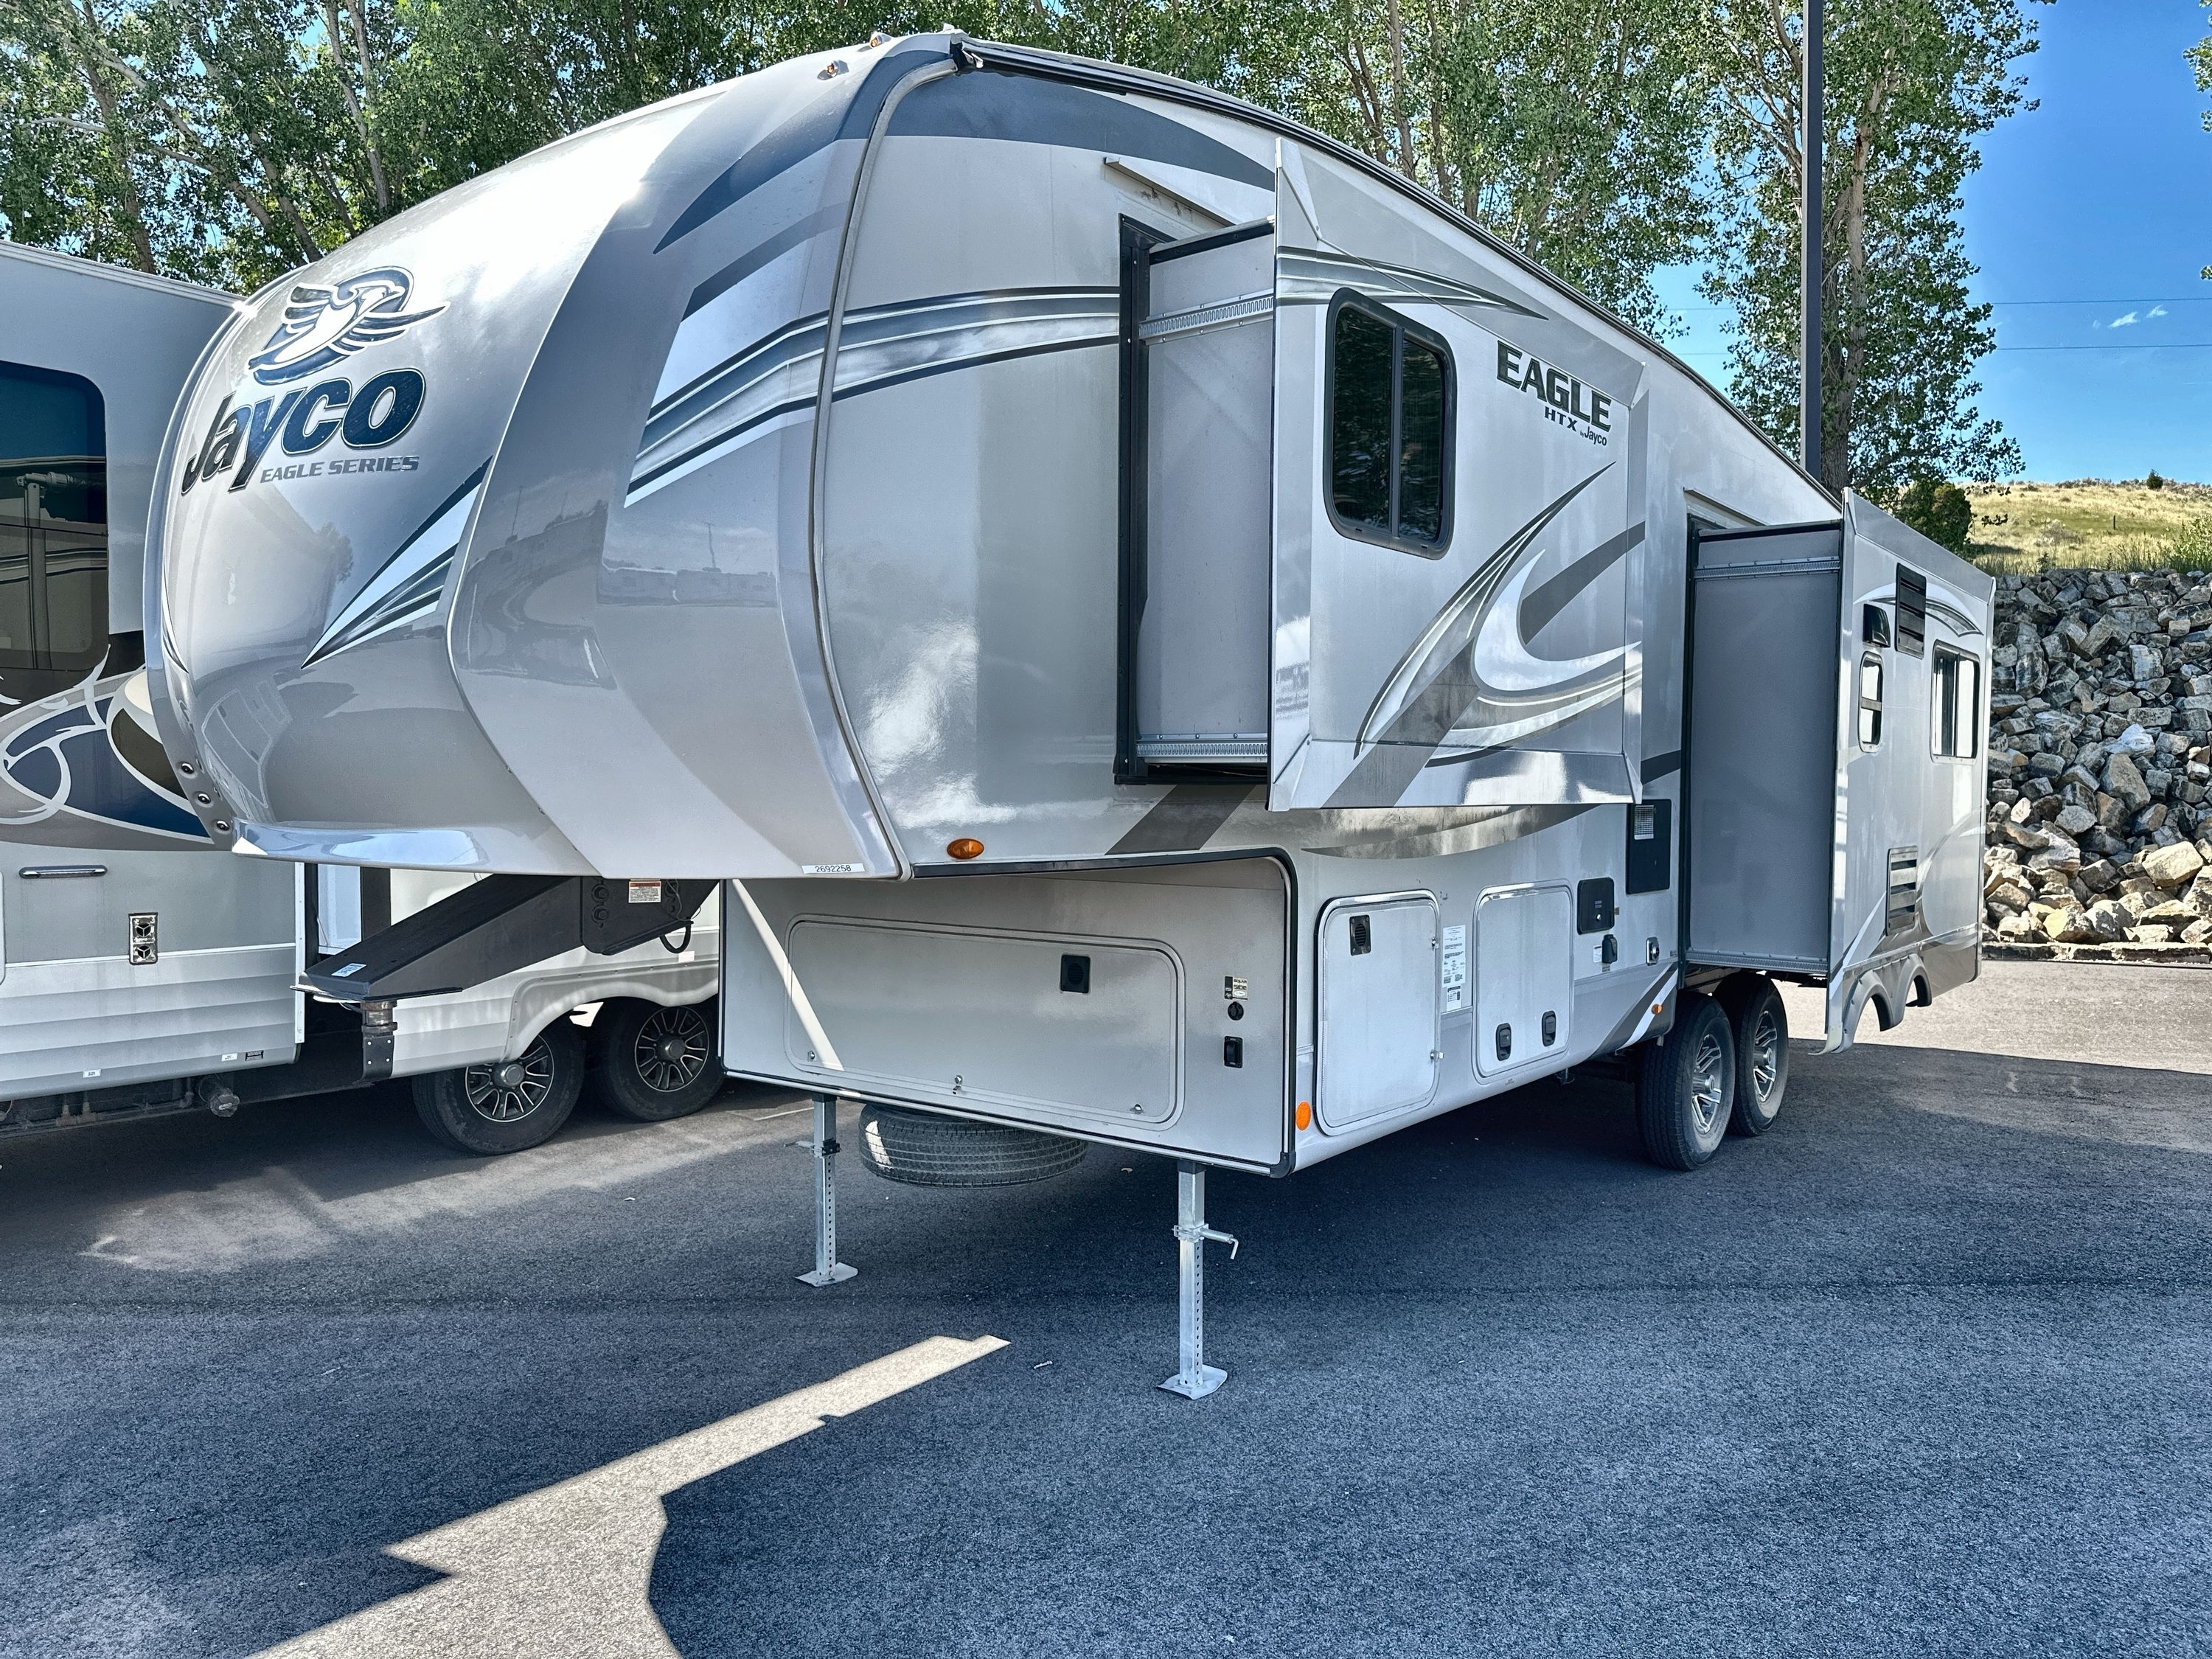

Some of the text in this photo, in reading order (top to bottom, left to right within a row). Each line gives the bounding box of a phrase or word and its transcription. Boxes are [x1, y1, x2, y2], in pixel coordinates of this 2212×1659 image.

[1497, 340, 1612, 432] EAGLE
[181, 368, 426, 495] Jayco
[1544, 406, 1577, 431] HTX
[1584, 425, 1607, 446] Jayco
[260, 455, 420, 484] EAGLE SERIES
[815, 864, 852, 873] 2692258
